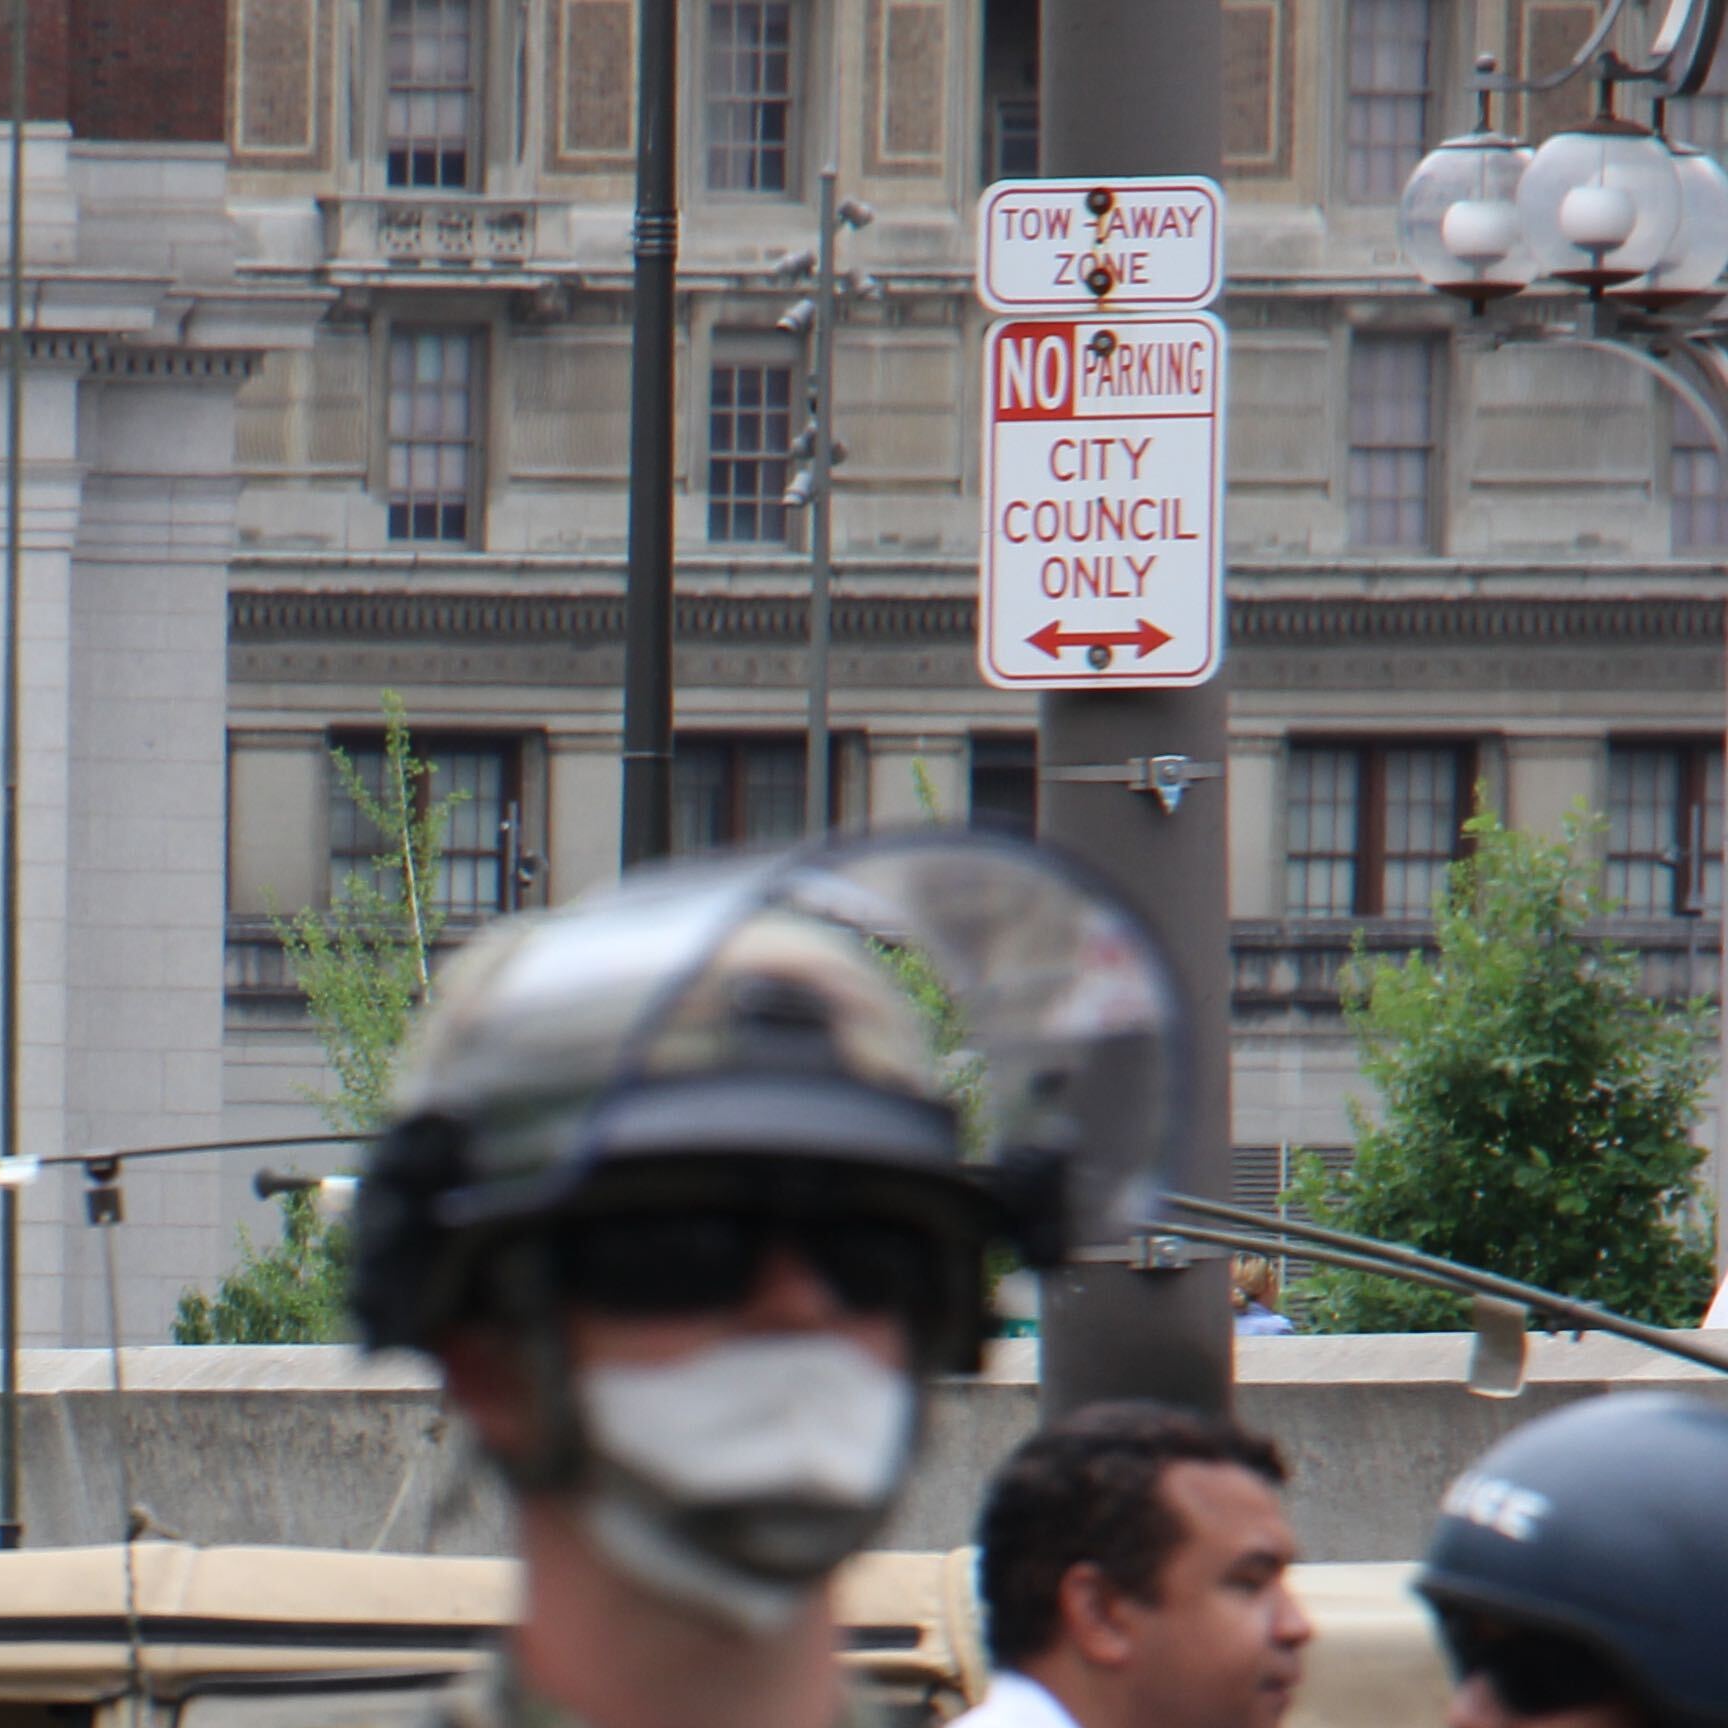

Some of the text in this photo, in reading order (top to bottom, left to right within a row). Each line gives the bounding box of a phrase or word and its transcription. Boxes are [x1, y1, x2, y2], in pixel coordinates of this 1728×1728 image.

[1053, 251, 1151, 285] ZONE
[999, 335, 1205, 410] NO PARKING
[1049, 437, 1153, 482] CITY
[1002, 497, 1199, 544] COUNCIL
[1041, 555, 1158, 599] ONLY
